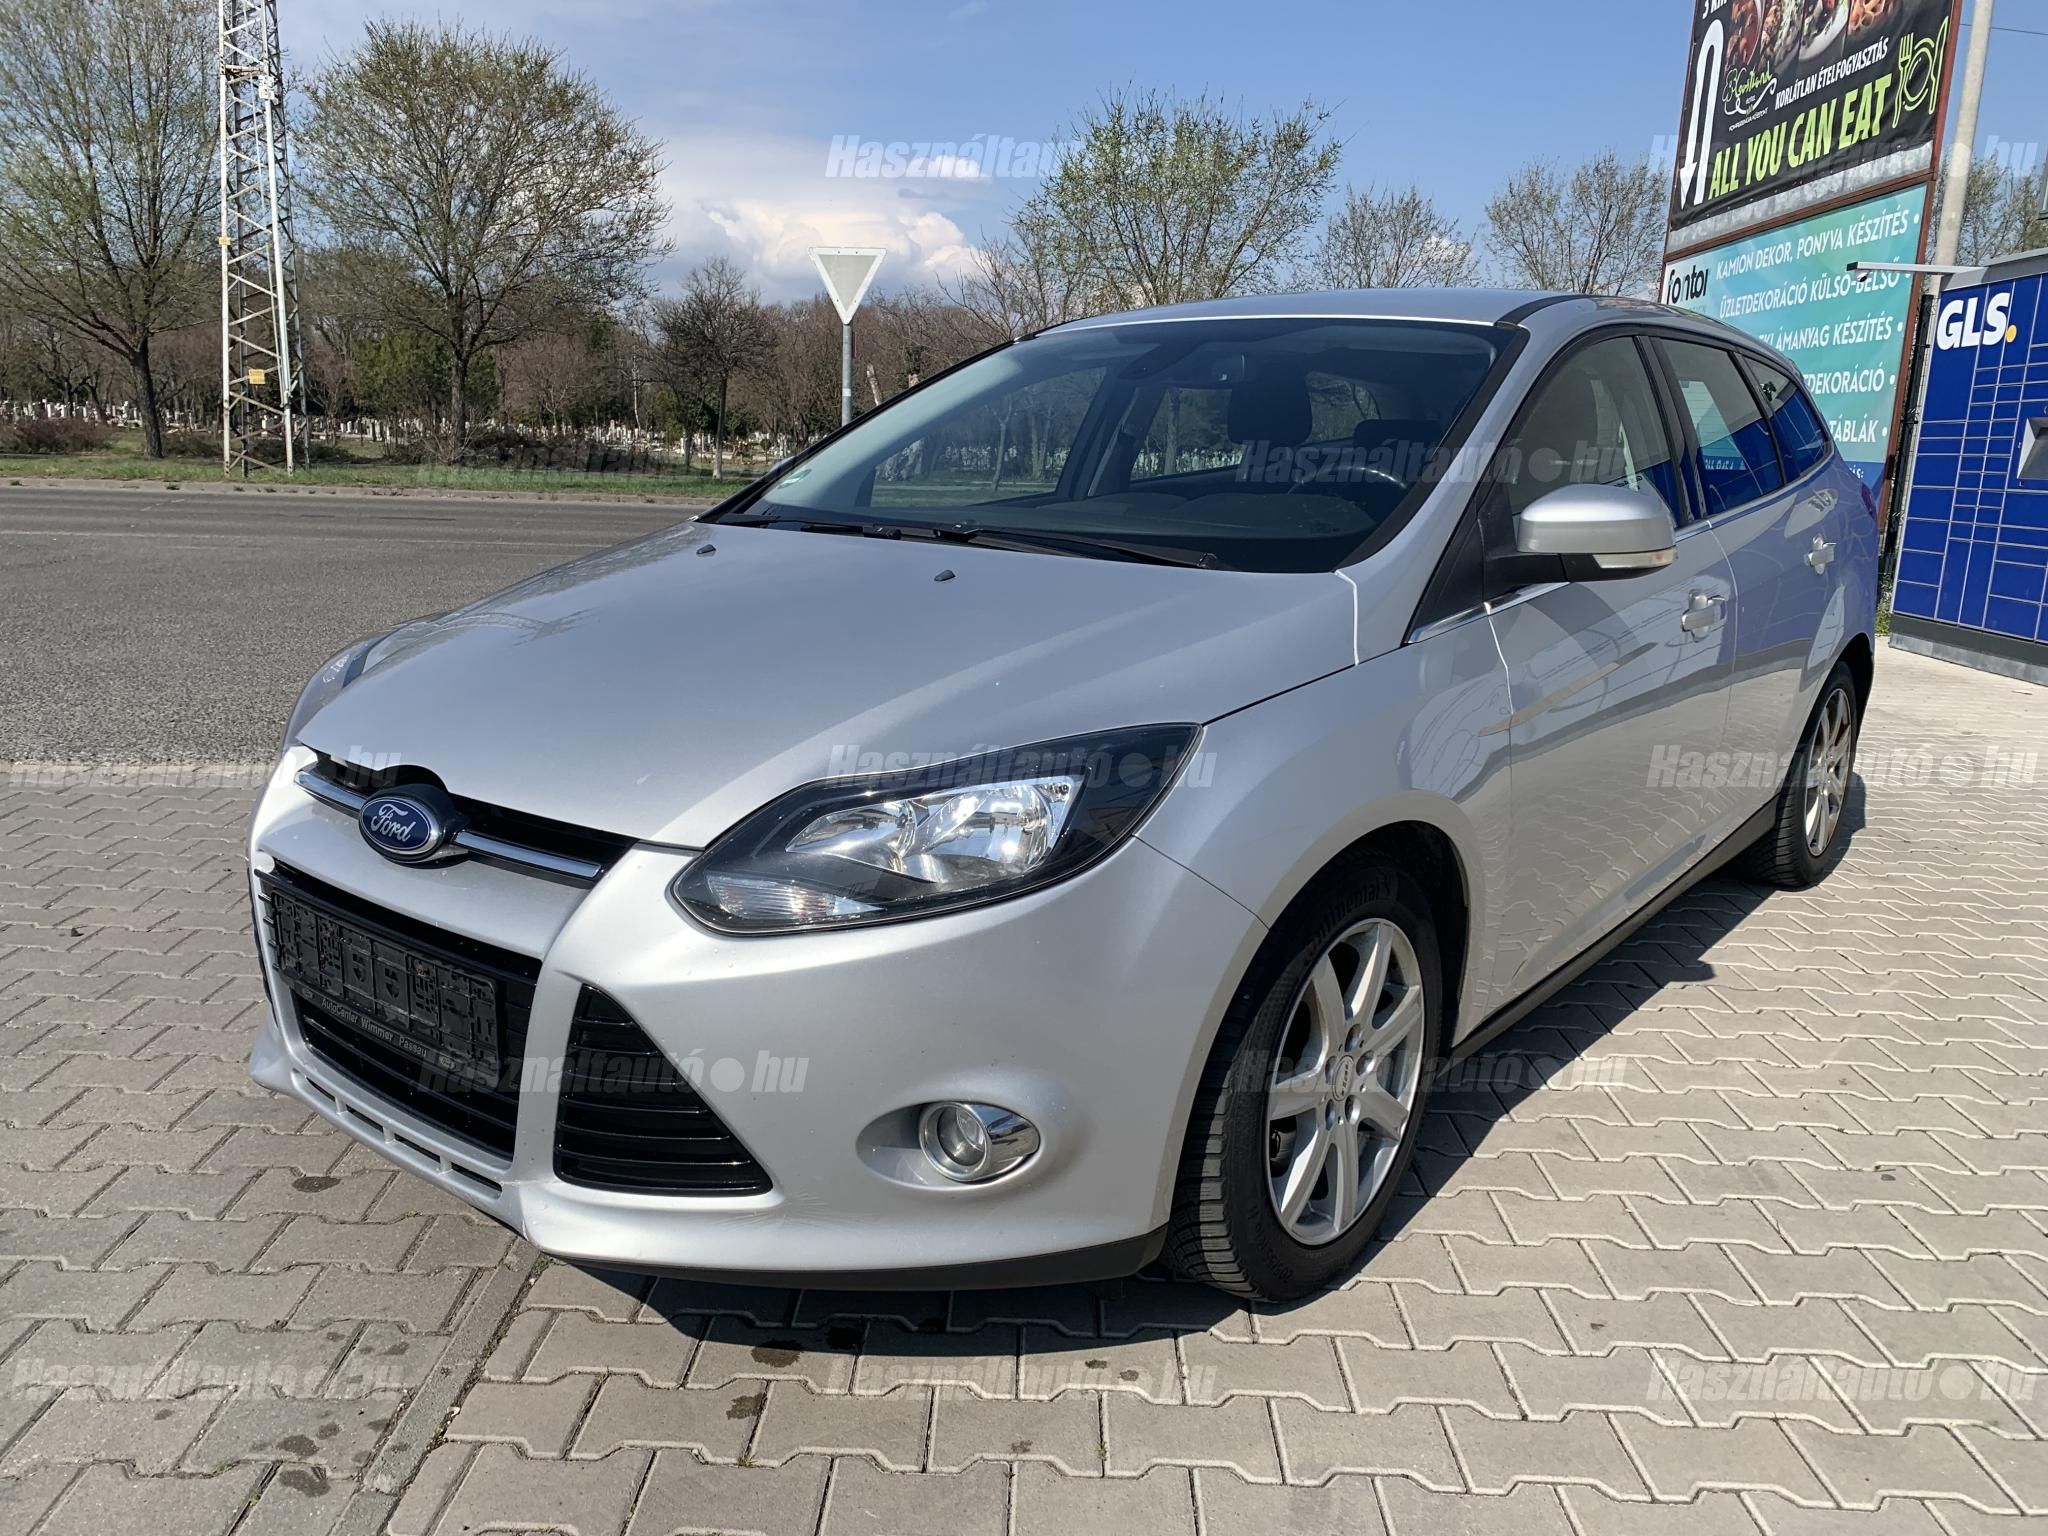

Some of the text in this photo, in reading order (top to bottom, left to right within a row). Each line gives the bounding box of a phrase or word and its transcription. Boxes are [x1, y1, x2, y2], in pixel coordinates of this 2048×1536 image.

[1775, 36, 1889, 111] KORLÁTLAN ÉTELFOGYASZTÁS
[1708, 73, 1892, 200] ALL YOU CAN EAT
[1716, 252, 1754, 280] KAMION
[1796, 228, 1843, 260] PONYVA
[1846, 204, 1909, 247] KÉSZÍTÉS
[1720, 276, 1808, 319] ÜZLETDEKORÁCIÓ
[1833, 310, 1894, 345] KÉSZÍTÉS
[1829, 412, 1879, 443] TÁBLÁK
[371, 803, 416, 842] Ford
[361, 1016, 394, 1042] Wimmer
[400, 1036, 427, 1058] Passau
